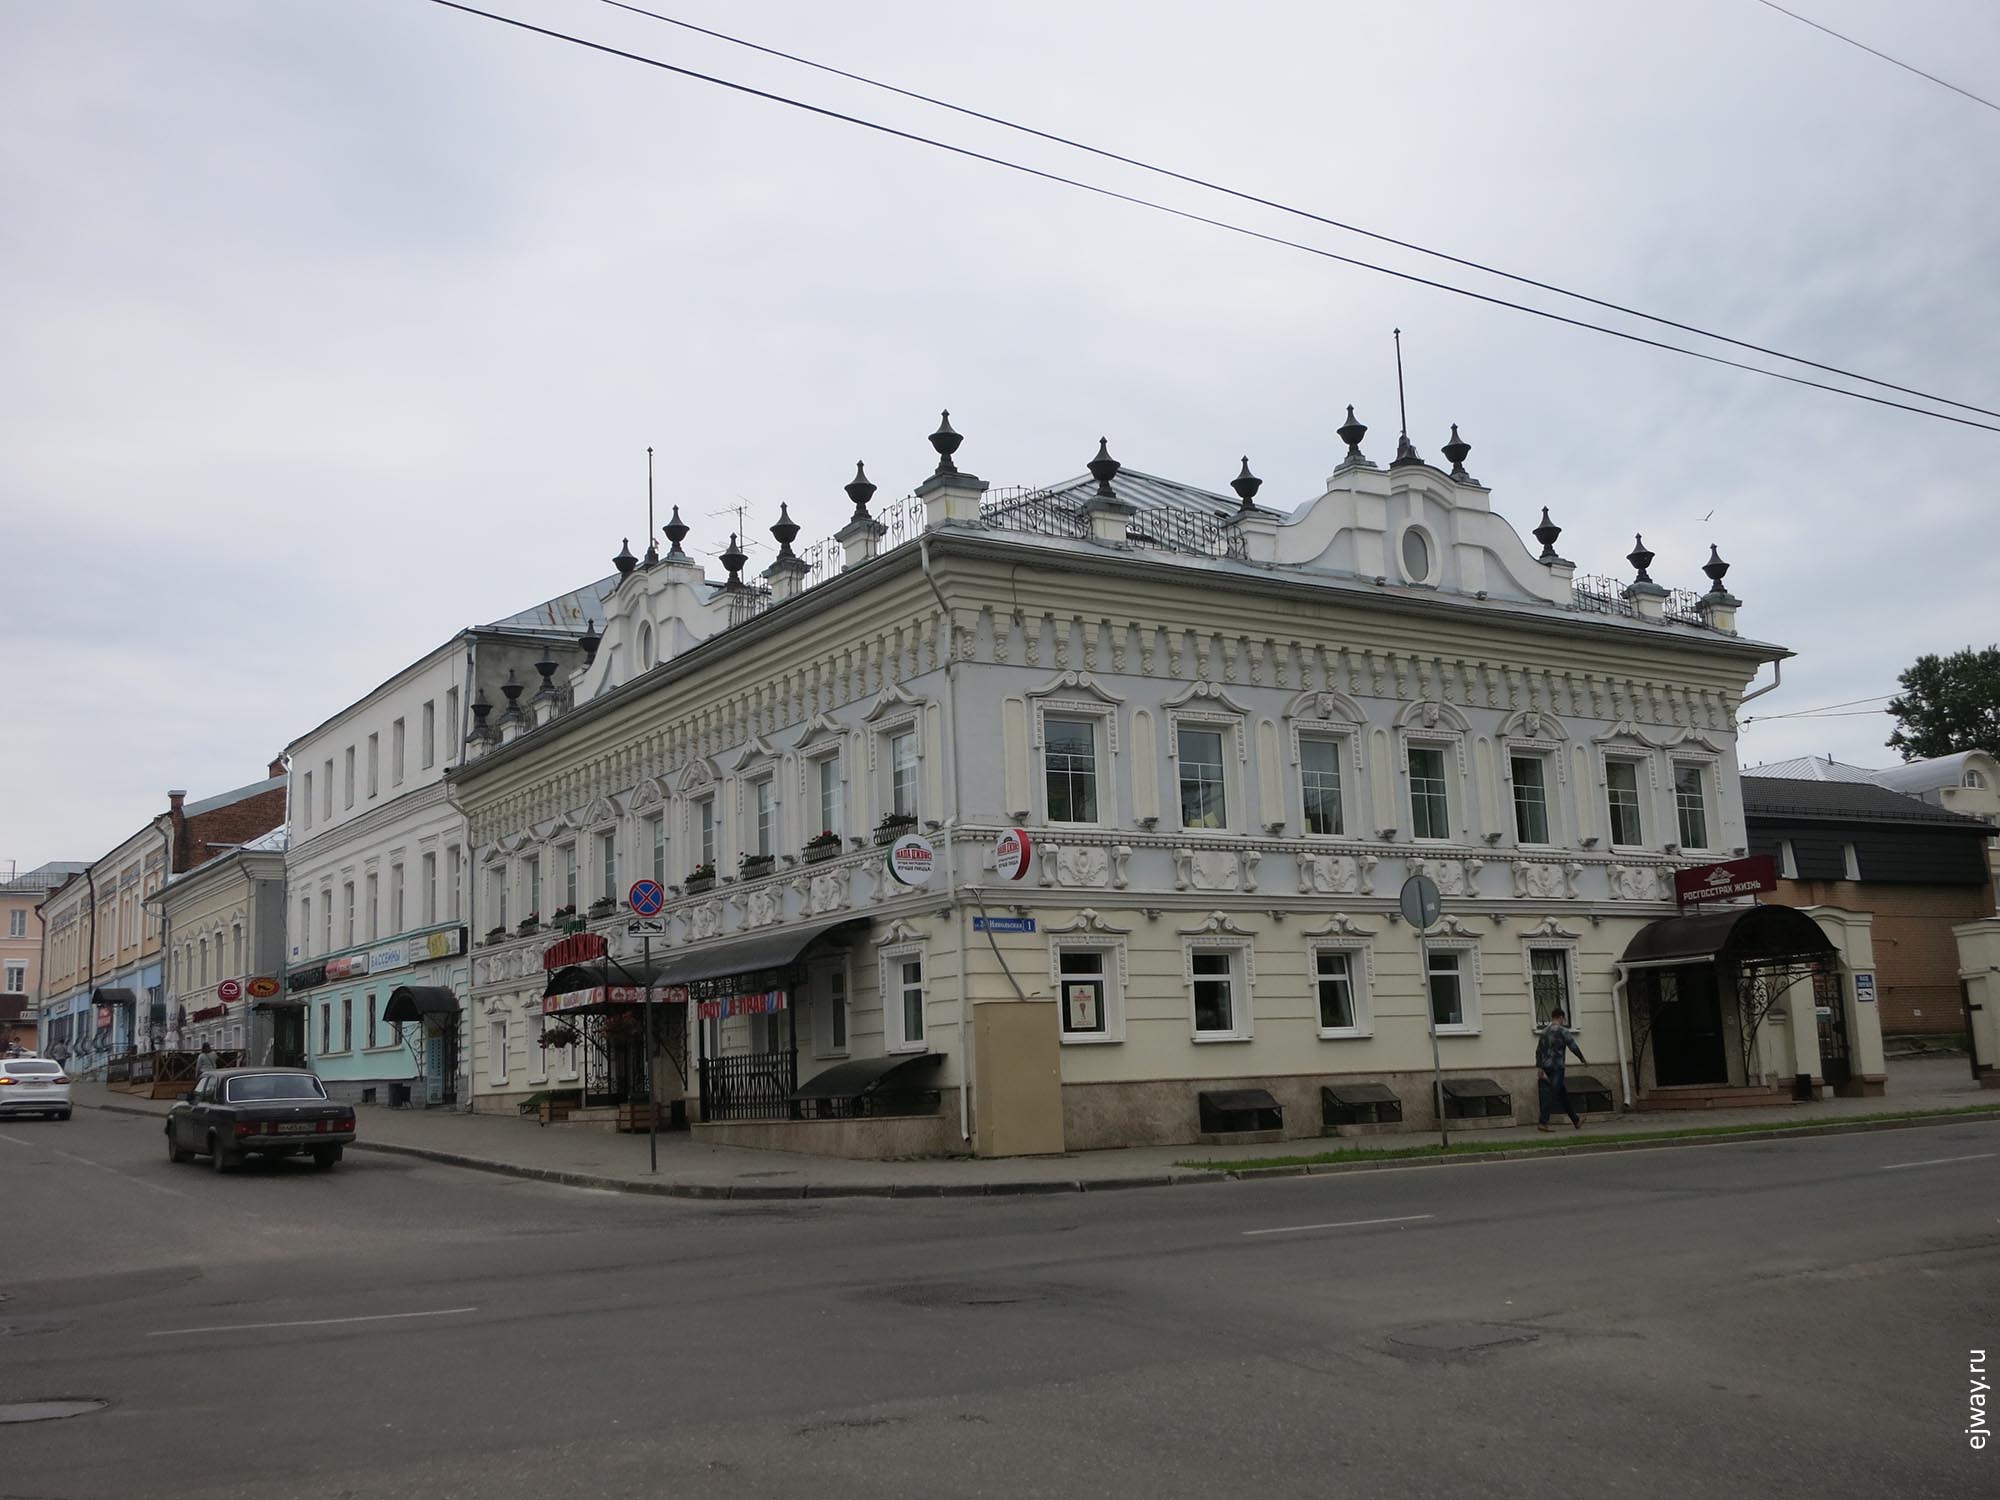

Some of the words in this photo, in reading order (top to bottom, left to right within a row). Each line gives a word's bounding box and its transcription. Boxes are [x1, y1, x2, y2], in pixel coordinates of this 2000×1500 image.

[1683, 885, 1733, 901] РОСГОССТРАХ
[1734, 880, 1762, 892] ЖИЗНЬ
[371, 948, 401, 968] БАССЕЙНЫ
